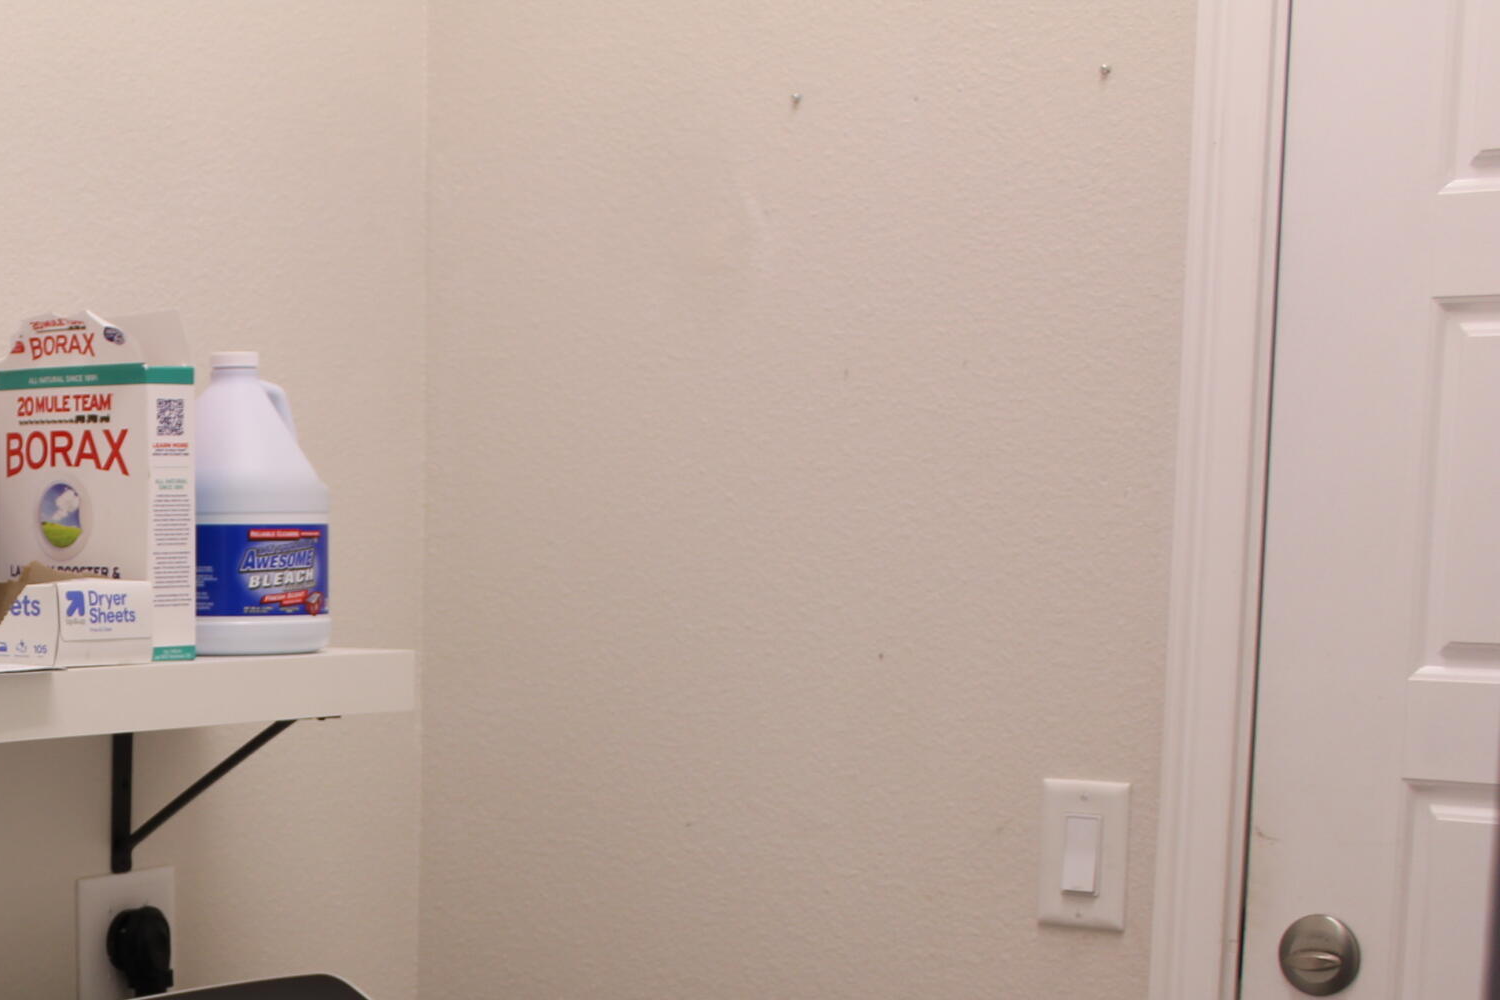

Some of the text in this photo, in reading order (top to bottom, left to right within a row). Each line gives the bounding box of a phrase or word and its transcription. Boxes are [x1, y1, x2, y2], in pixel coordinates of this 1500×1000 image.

[29, 333, 95, 360] BORAX
[17, 393, 112, 417] 20 MULE TEAM
[6, 428, 129, 477] BORAX
[240, 548, 315, 571] AWESOME
[112, 566, 121, 579] &
[248, 569, 314, 589] BLEACH
[10, 595, 41, 617] ets
[88, 590, 127, 610] Dryer
[89, 608, 136, 624] Sheets
[33, 644, 48, 654] 105
